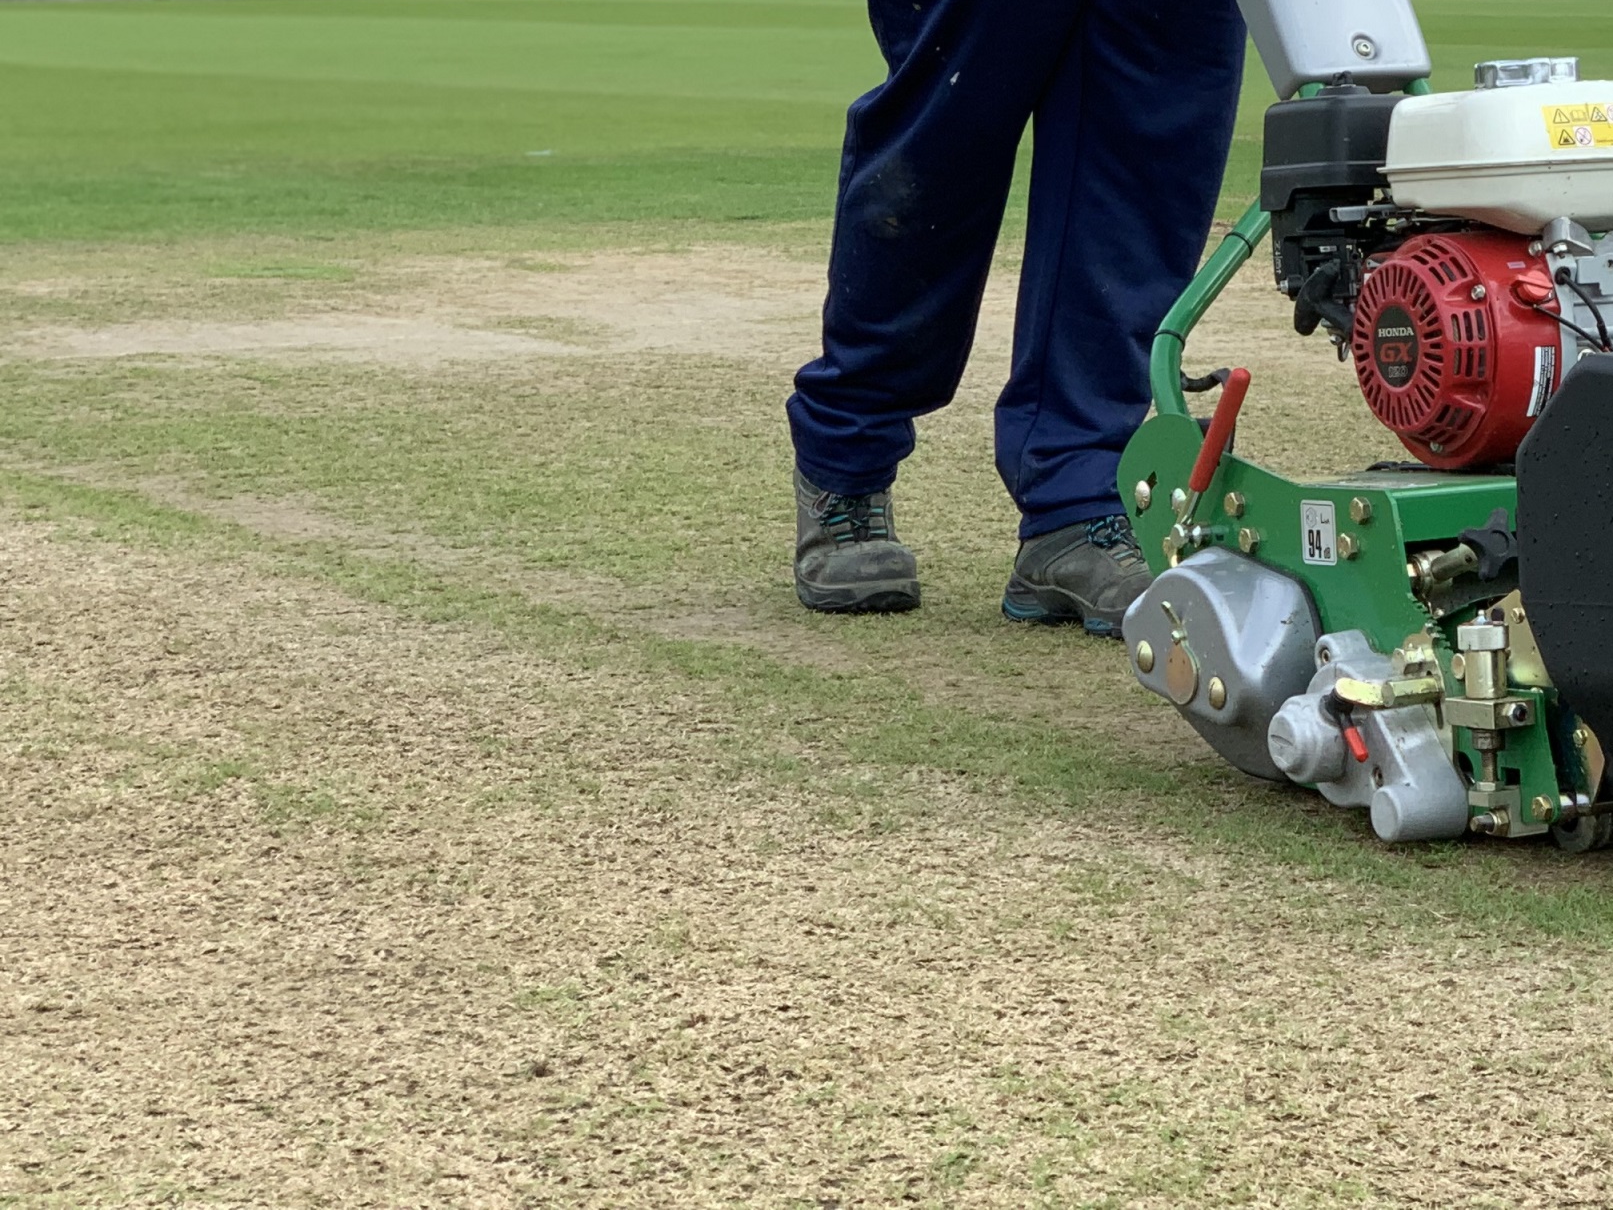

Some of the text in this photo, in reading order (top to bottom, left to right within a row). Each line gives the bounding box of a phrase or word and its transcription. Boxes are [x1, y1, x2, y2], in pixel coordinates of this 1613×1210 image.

[1378, 327, 1414, 338] HONDA
[1380, 342, 1414, 363] GX
[1308, 529, 1322, 558] 94
